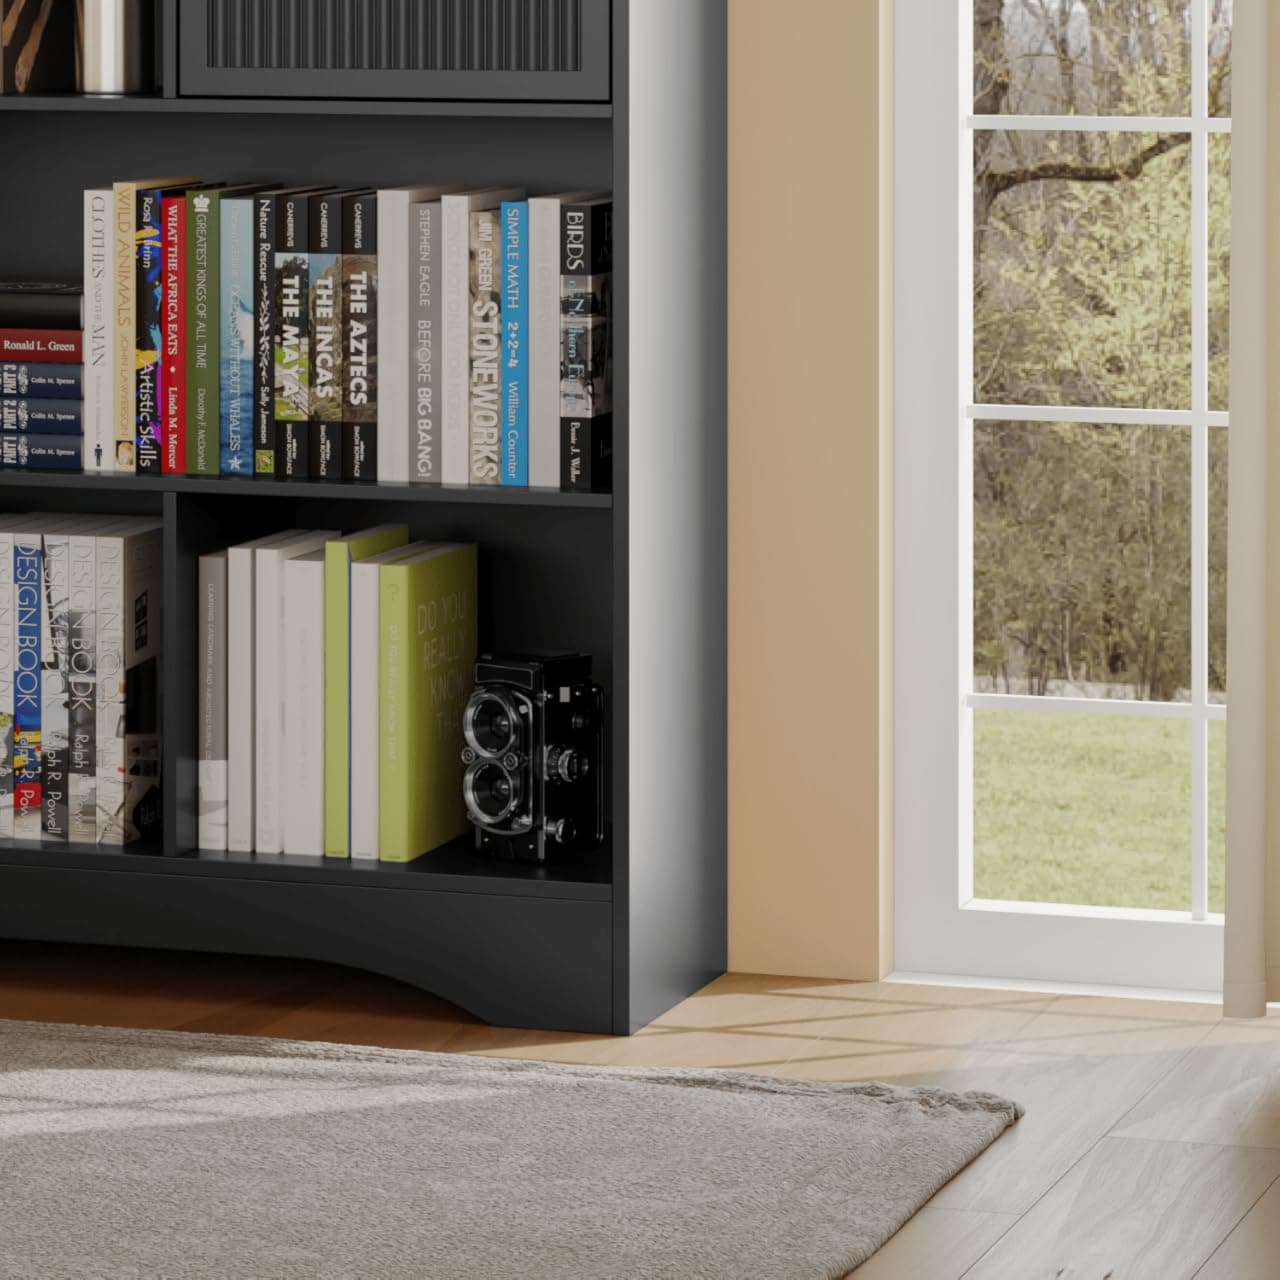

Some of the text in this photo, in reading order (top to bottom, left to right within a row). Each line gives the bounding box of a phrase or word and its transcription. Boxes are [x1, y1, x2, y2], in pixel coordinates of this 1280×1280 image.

[118, 191, 131, 326] WILD ANIMALS
[168, 205, 178, 355] WHAT THE AFRICA EATS
[196, 214, 206, 368] GREATEST KINGS OF ALL TIME
[259, 200, 270, 281] Nature Rescue
[420, 209, 430, 306] STEPHEN EAGLE
[478, 220, 492, 291] JIM GREEN
[506, 208, 520, 308] SIMPLE MATH
[566, 212, 584, 270] BIRDS
[3, 340, 75, 351] Ronald L. Green
[282, 275, 299, 397] THE MAYA
[316, 276, 333, 398] THE INCAS
[350, 271, 367, 405] THE AZTECS
[140, 360, 156, 467] Artistic Skills
[417, 388, 432, 416] BIG
[472, 300, 498, 478] STONEWORKS
[507, 381, 519, 478] William Counter
[417, 419, 432, 477] BANG!
[16, 543, 38, 707] DESIGN BOOK
